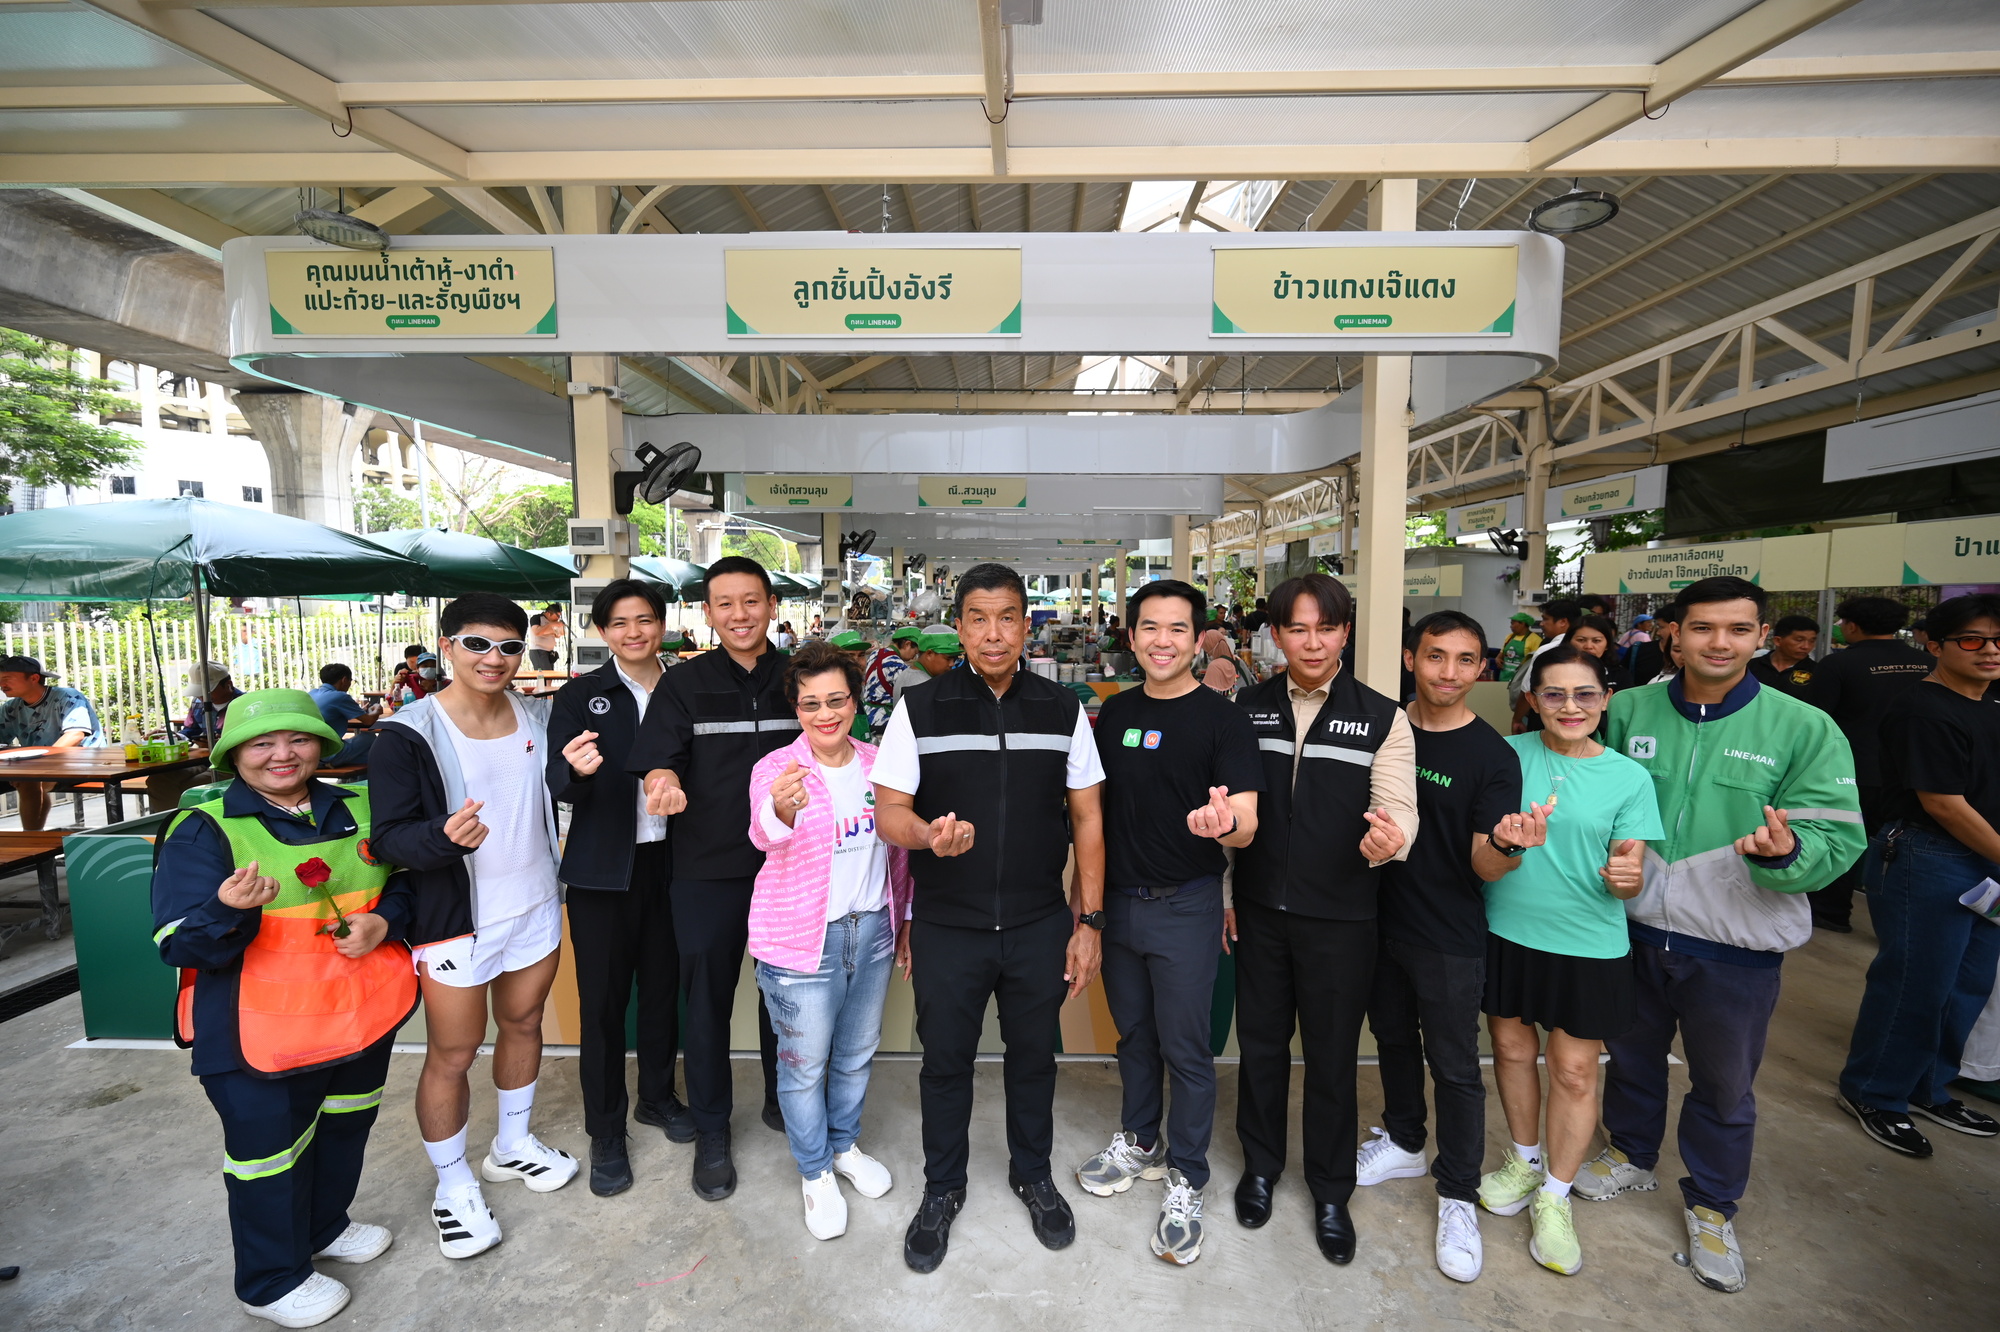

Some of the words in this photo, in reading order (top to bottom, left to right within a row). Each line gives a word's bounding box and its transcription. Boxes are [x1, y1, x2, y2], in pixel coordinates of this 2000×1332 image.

[306, 251, 515, 287] คุณมนน้ำเต้าหู้-งาดำ
[794, 267, 953, 308] ลูกชิ้นปิ้งอังรี
[1273, 270, 1456, 299] ข้าวแกงเจ๊แดง
[304, 287, 521, 313] แปะก้วย-และธัญพืชฯ
[1647, 549, 1724, 563] เกาเหลาเลือดหมู
[1329, 719, 1370, 737] กทม
[1416, 766, 1452, 788] EMAN
